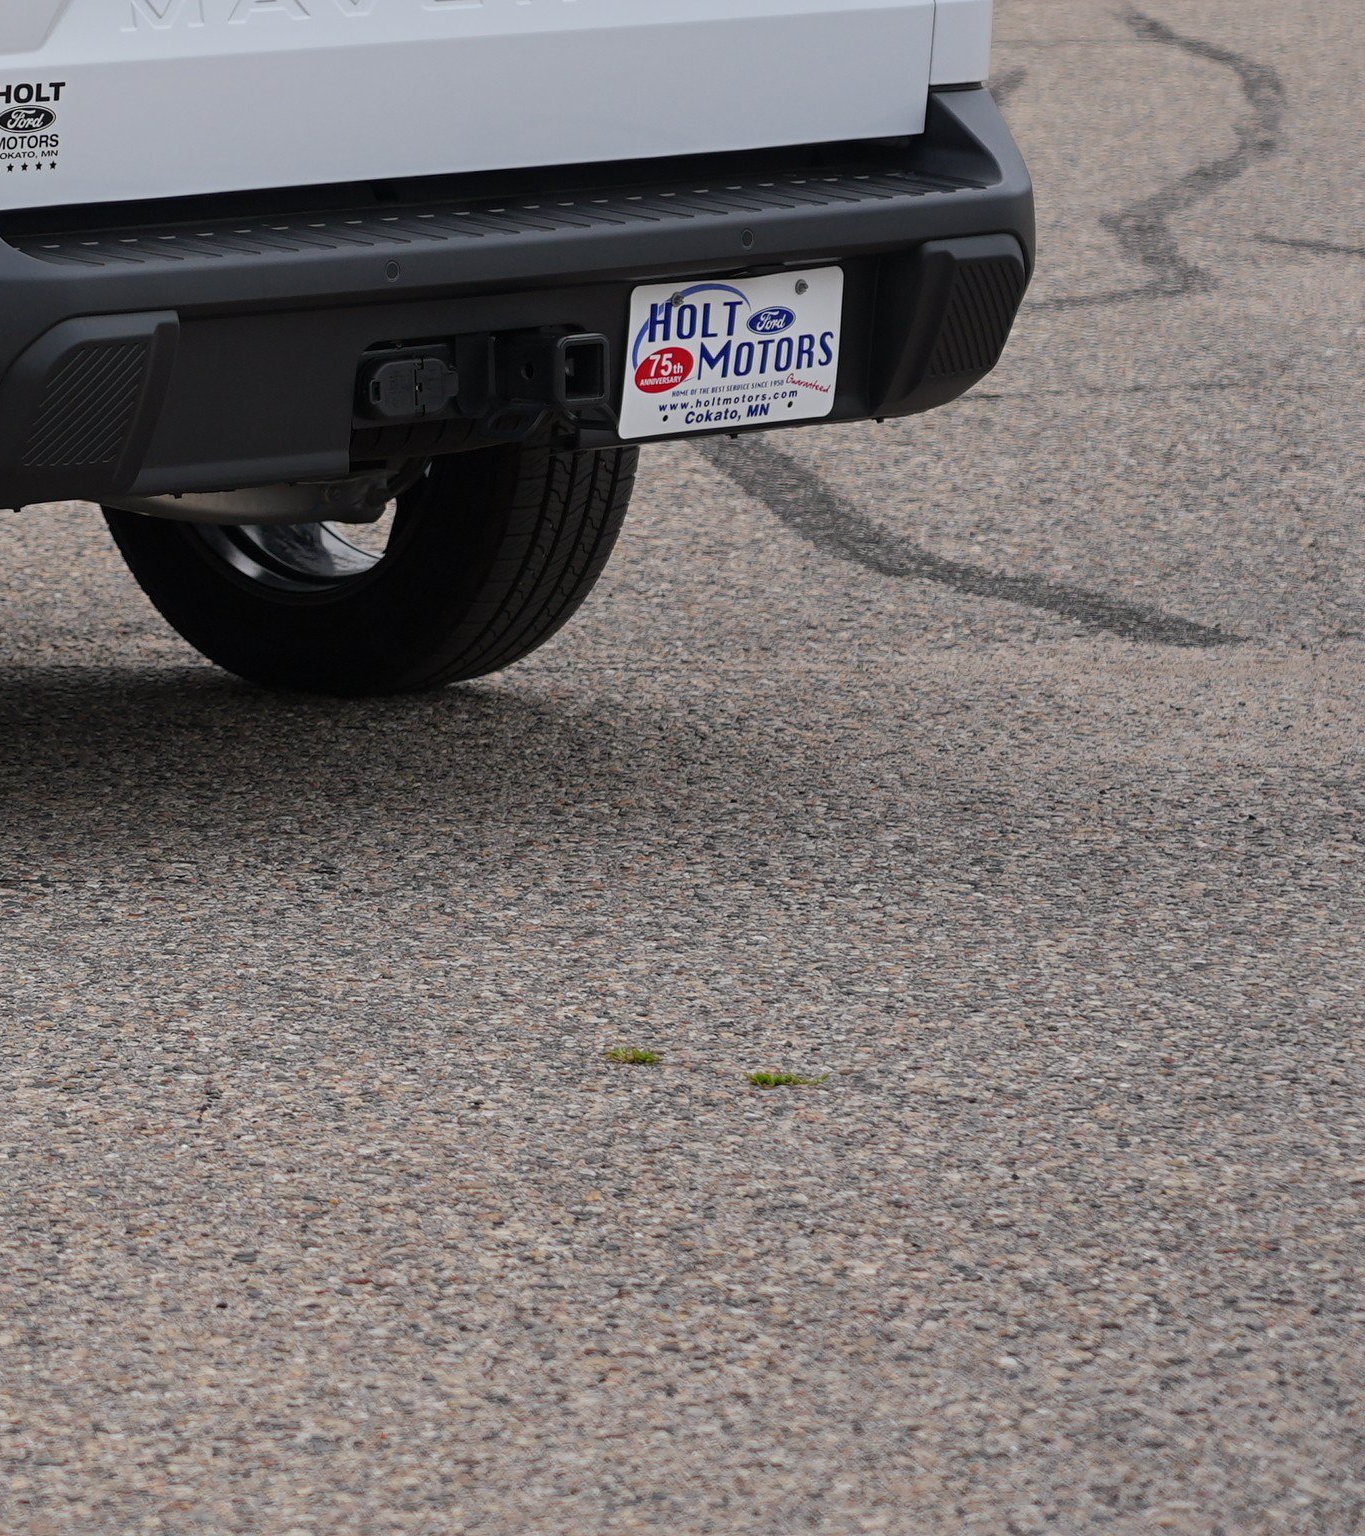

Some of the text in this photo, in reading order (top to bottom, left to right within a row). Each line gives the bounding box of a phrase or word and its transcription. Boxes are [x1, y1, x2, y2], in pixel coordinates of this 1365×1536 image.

[7, 109, 45, 129] Ford
[41, 150, 58, 158] MN
[648, 301, 743, 343] HOLT
[756, 310, 787, 331] Ford
[649, 353, 684, 377] 75th
[697, 331, 834, 380] MOTORS
[640, 375, 682, 387] ANNIVERSARY
[711, 385, 725, 393] BEST
[726, 383, 749, 392] SERVICE
[751, 381, 769, 389] SINCE
[786, 373, 831, 394] Guaranteed
[658, 389, 798, 412] www.holtmotors.com
[685, 403, 771, 425] Cokato, MN
